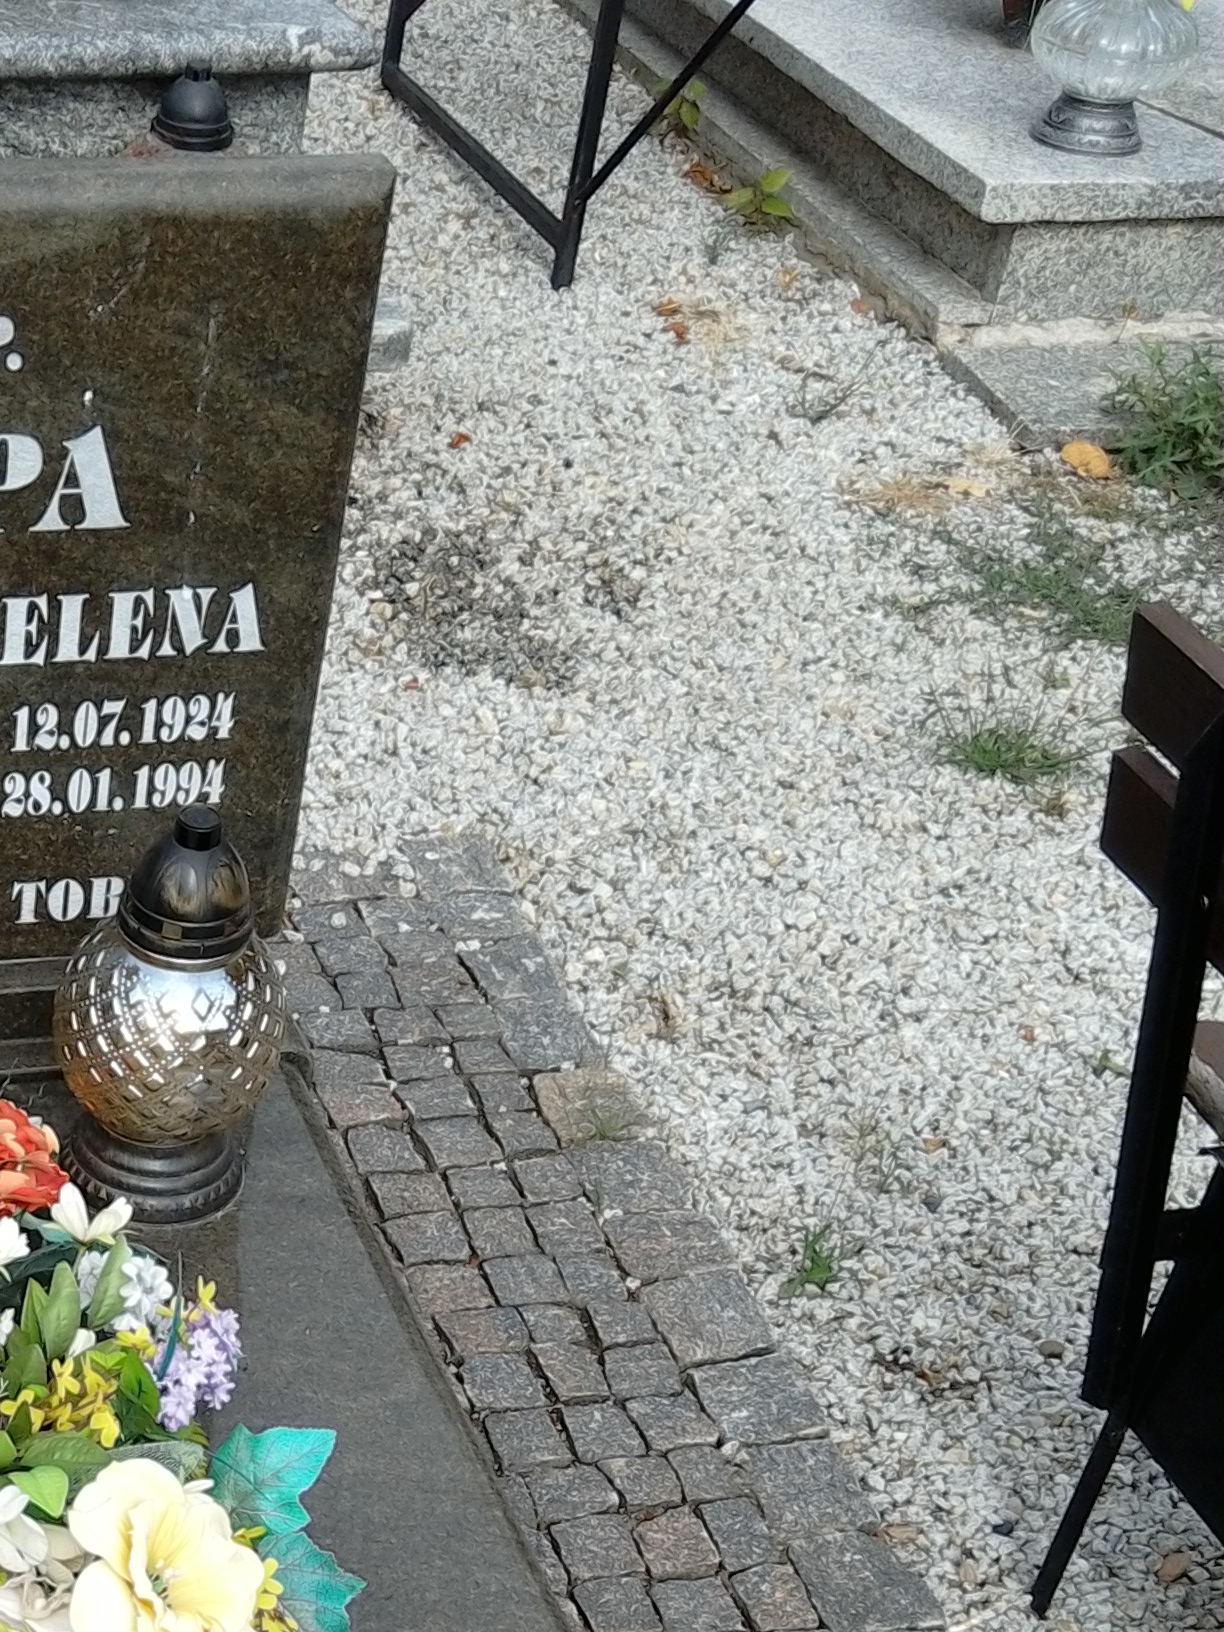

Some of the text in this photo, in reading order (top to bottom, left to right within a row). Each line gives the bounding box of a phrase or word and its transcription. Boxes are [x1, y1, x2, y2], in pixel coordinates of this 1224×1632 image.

[10, 691, 236, 752] 12.07.1924
[1, 758, 226, 818] 28.01.1994
[11, 875, 126, 925] TOB
